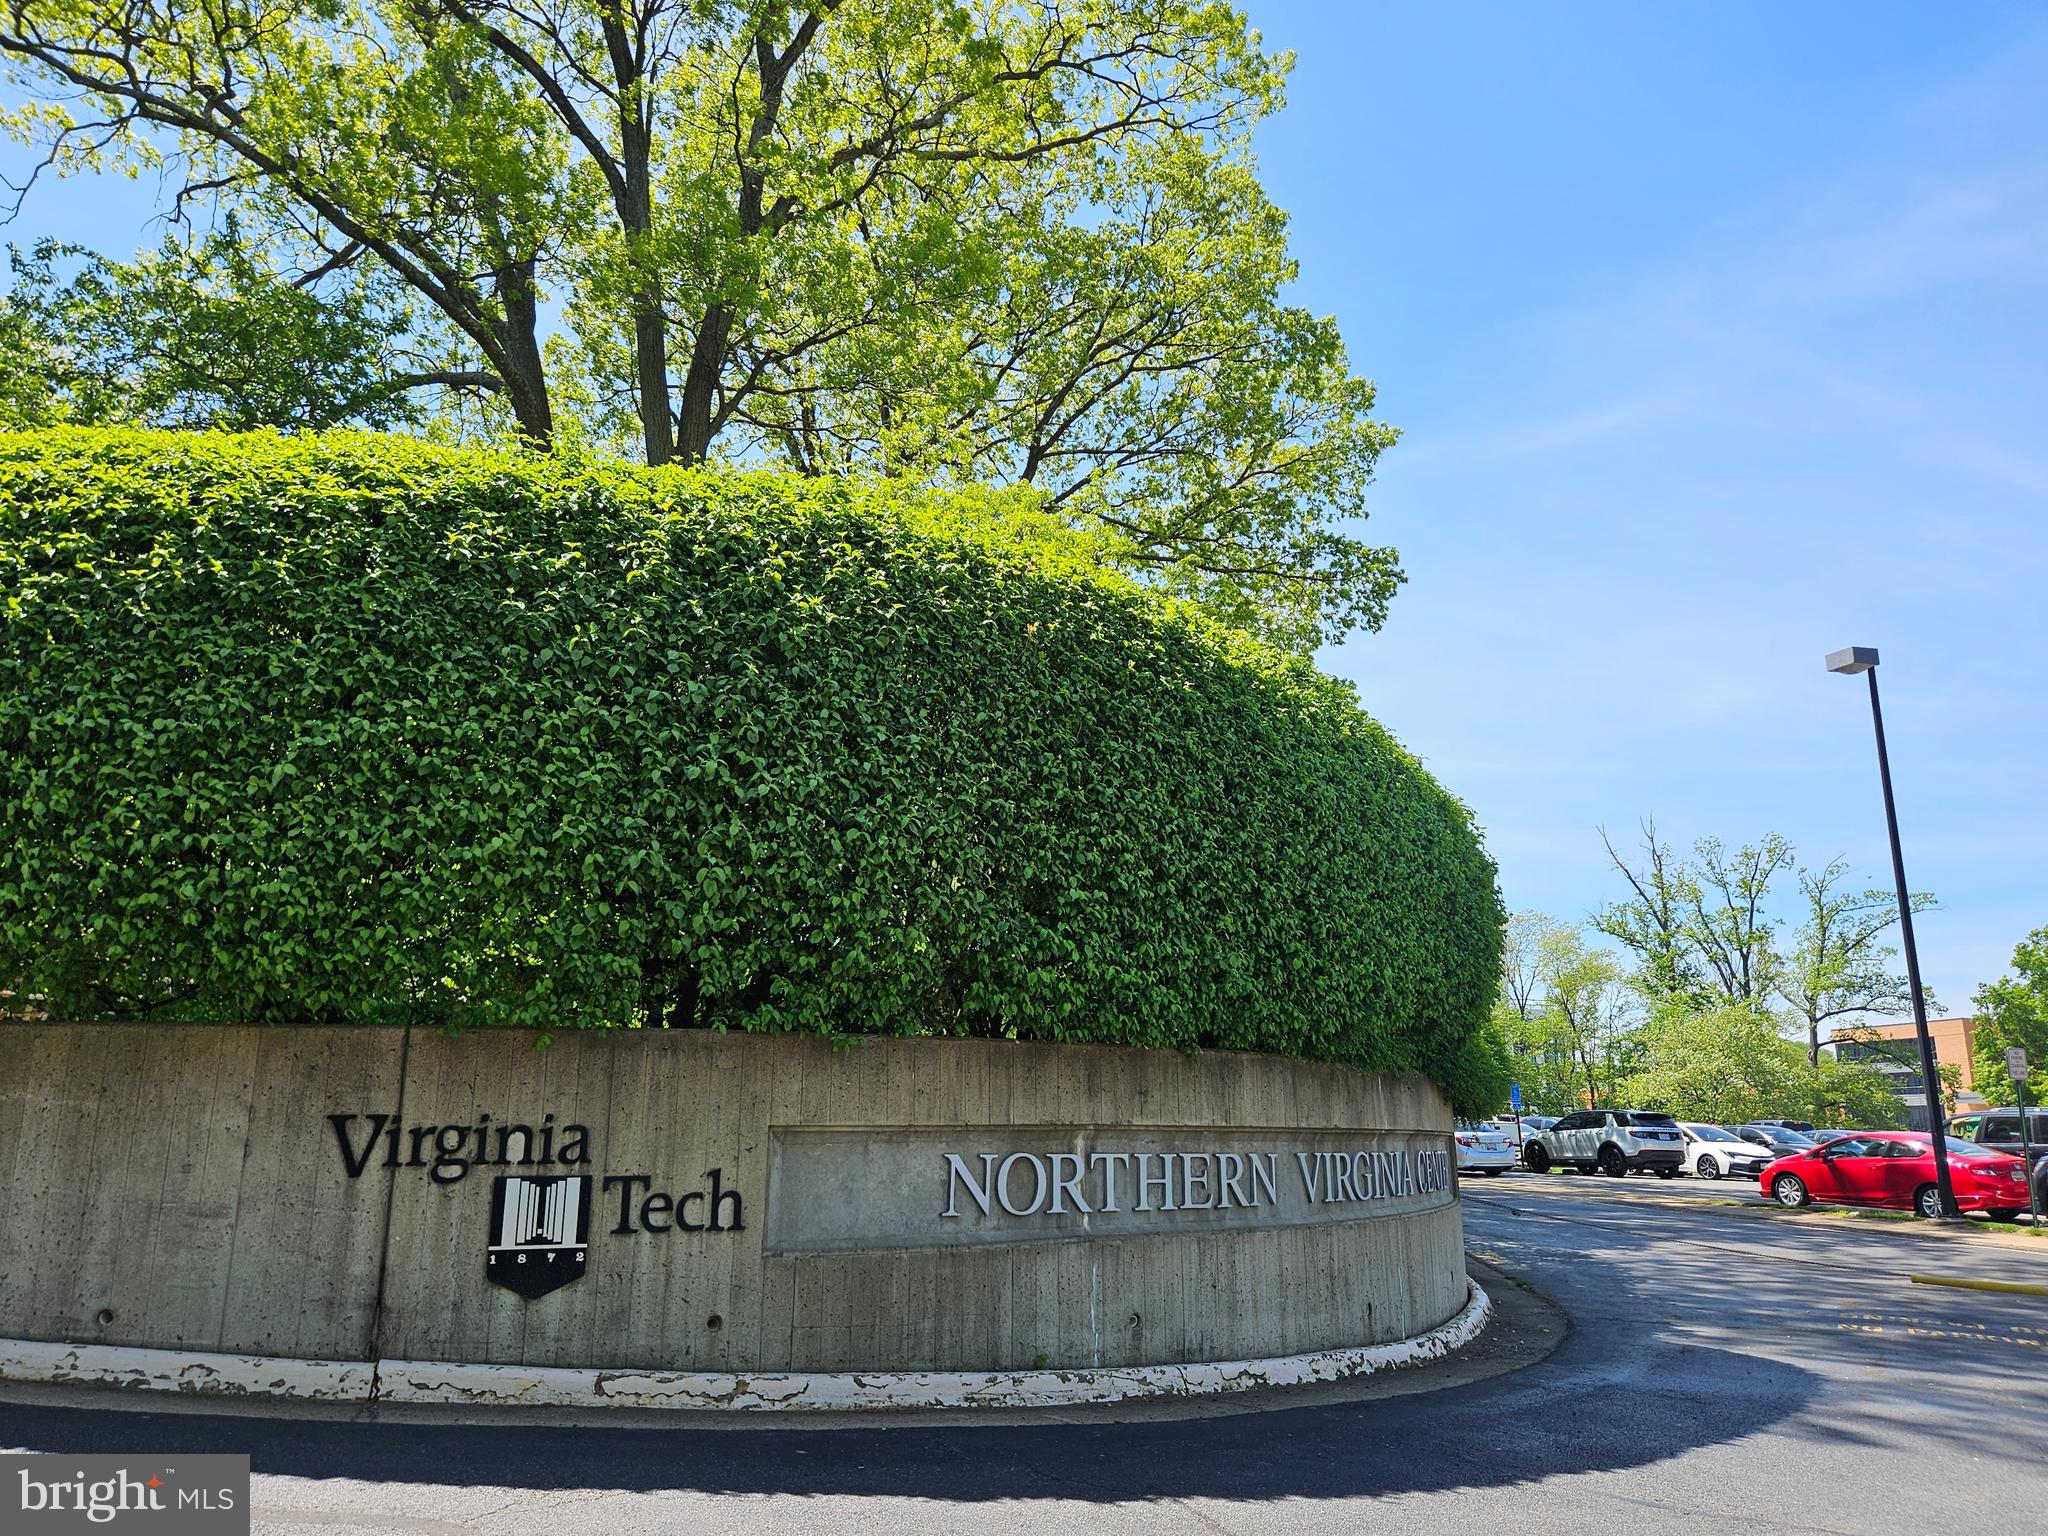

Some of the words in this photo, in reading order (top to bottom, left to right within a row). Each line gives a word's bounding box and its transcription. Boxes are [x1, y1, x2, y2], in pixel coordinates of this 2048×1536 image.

[328, 1114, 592, 1183] Virginia
[603, 1168, 746, 1235] Tech
[940, 1152, 1280, 1217] NORTHERN
[1297, 1150, 1415, 1203] VIRGINIA
